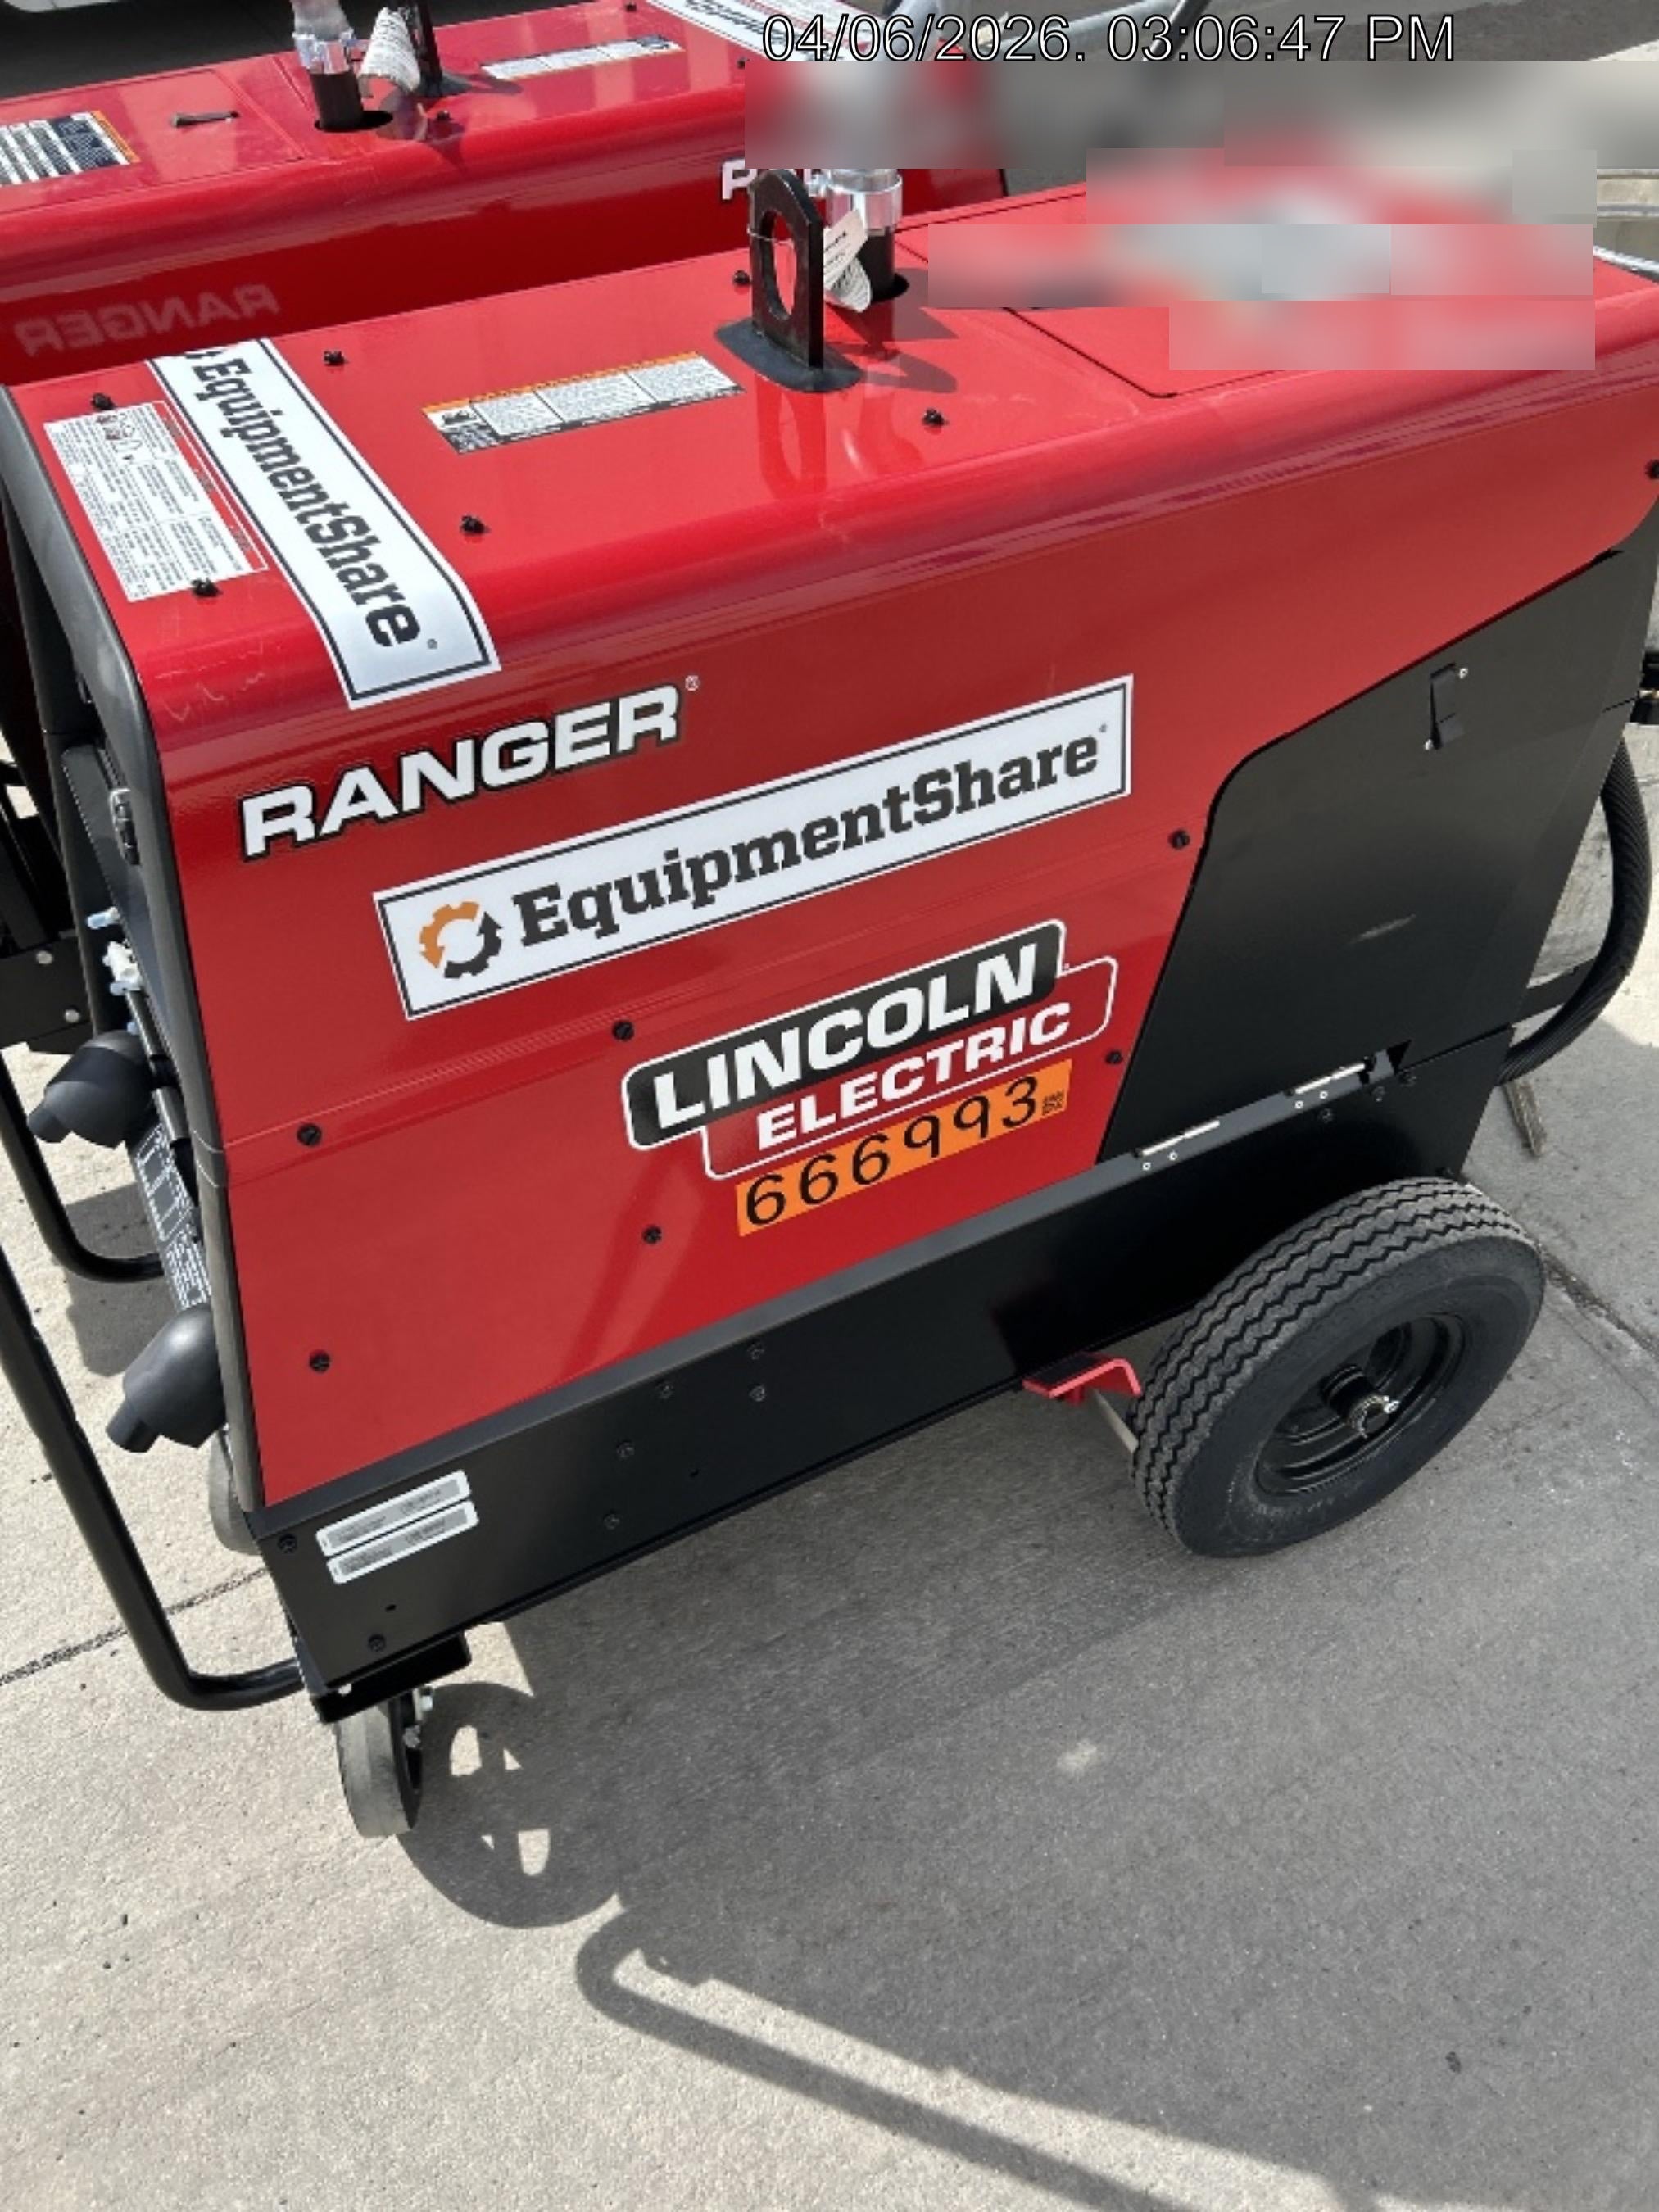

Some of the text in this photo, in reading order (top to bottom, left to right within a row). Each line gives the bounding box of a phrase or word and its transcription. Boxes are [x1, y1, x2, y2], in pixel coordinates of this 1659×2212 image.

[193, 358, 421, 648] EquipmentShare
[242, 683, 681, 859] RANGER
[513, 735, 1099, 947] EquipmentShare
[653, 943, 1036, 1129] LINCOLN
[758, 1001, 1072, 1151] ELECTRIC
[746, 1076, 1038, 1226] 666993
